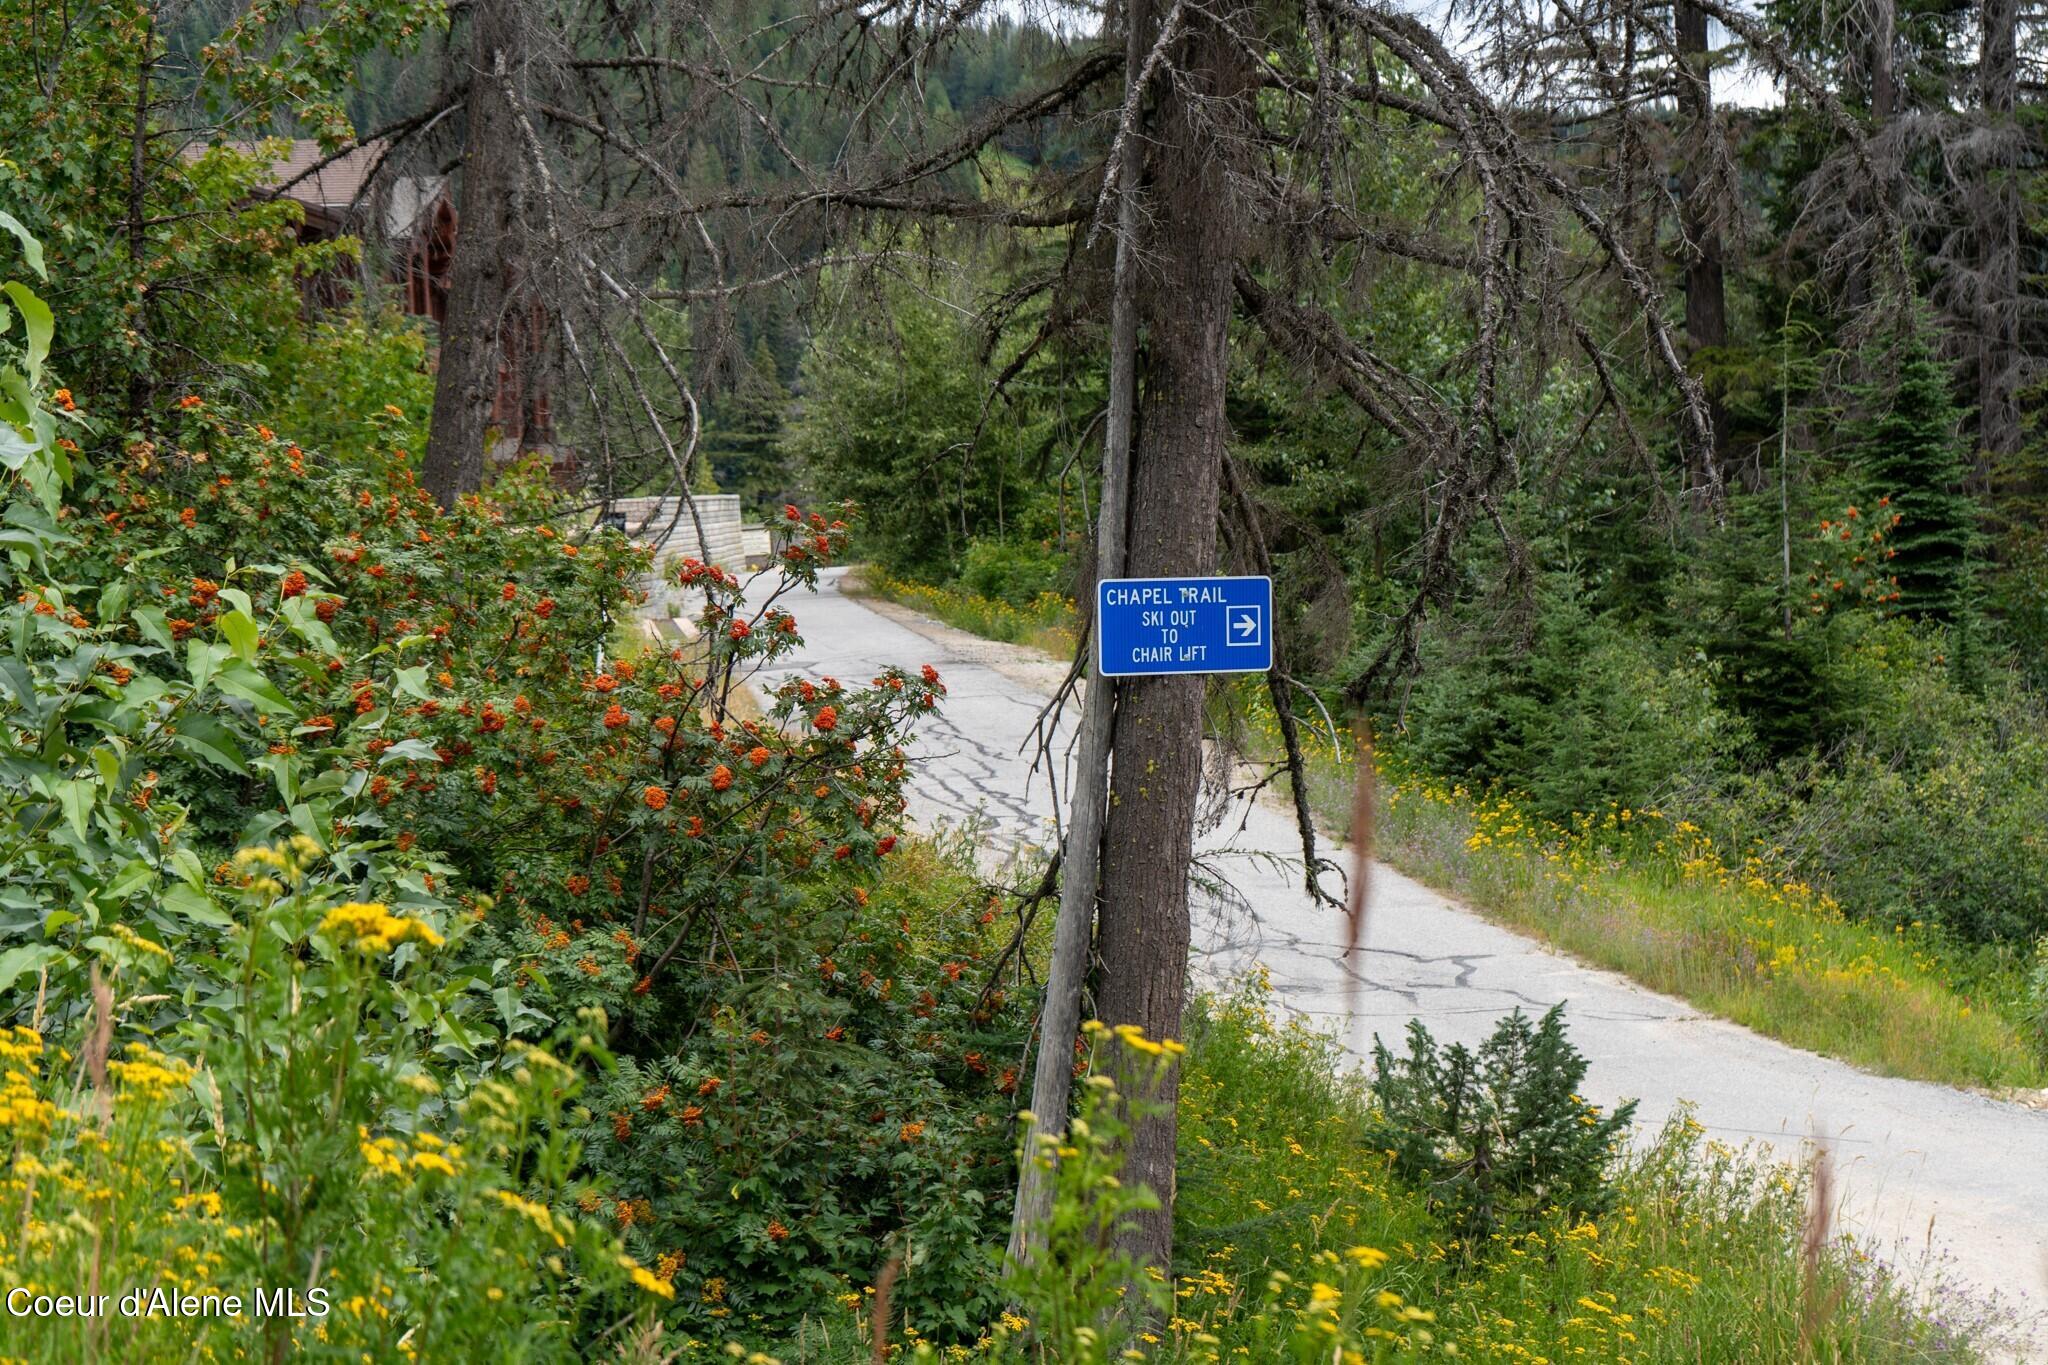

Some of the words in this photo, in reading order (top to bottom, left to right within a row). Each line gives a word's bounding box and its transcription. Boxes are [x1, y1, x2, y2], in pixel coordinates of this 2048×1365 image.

[1106, 588, 1173, 606] CHAPEL
[1178, 587, 1227, 604] TRAIL
[1142, 611, 1164, 627] SKI
[1170, 610, 1197, 626] OUT
[1161, 628, 1179, 644] TO
[1132, 647, 1172, 663] CHAIR
[1179, 645, 1207, 662] LIFT
